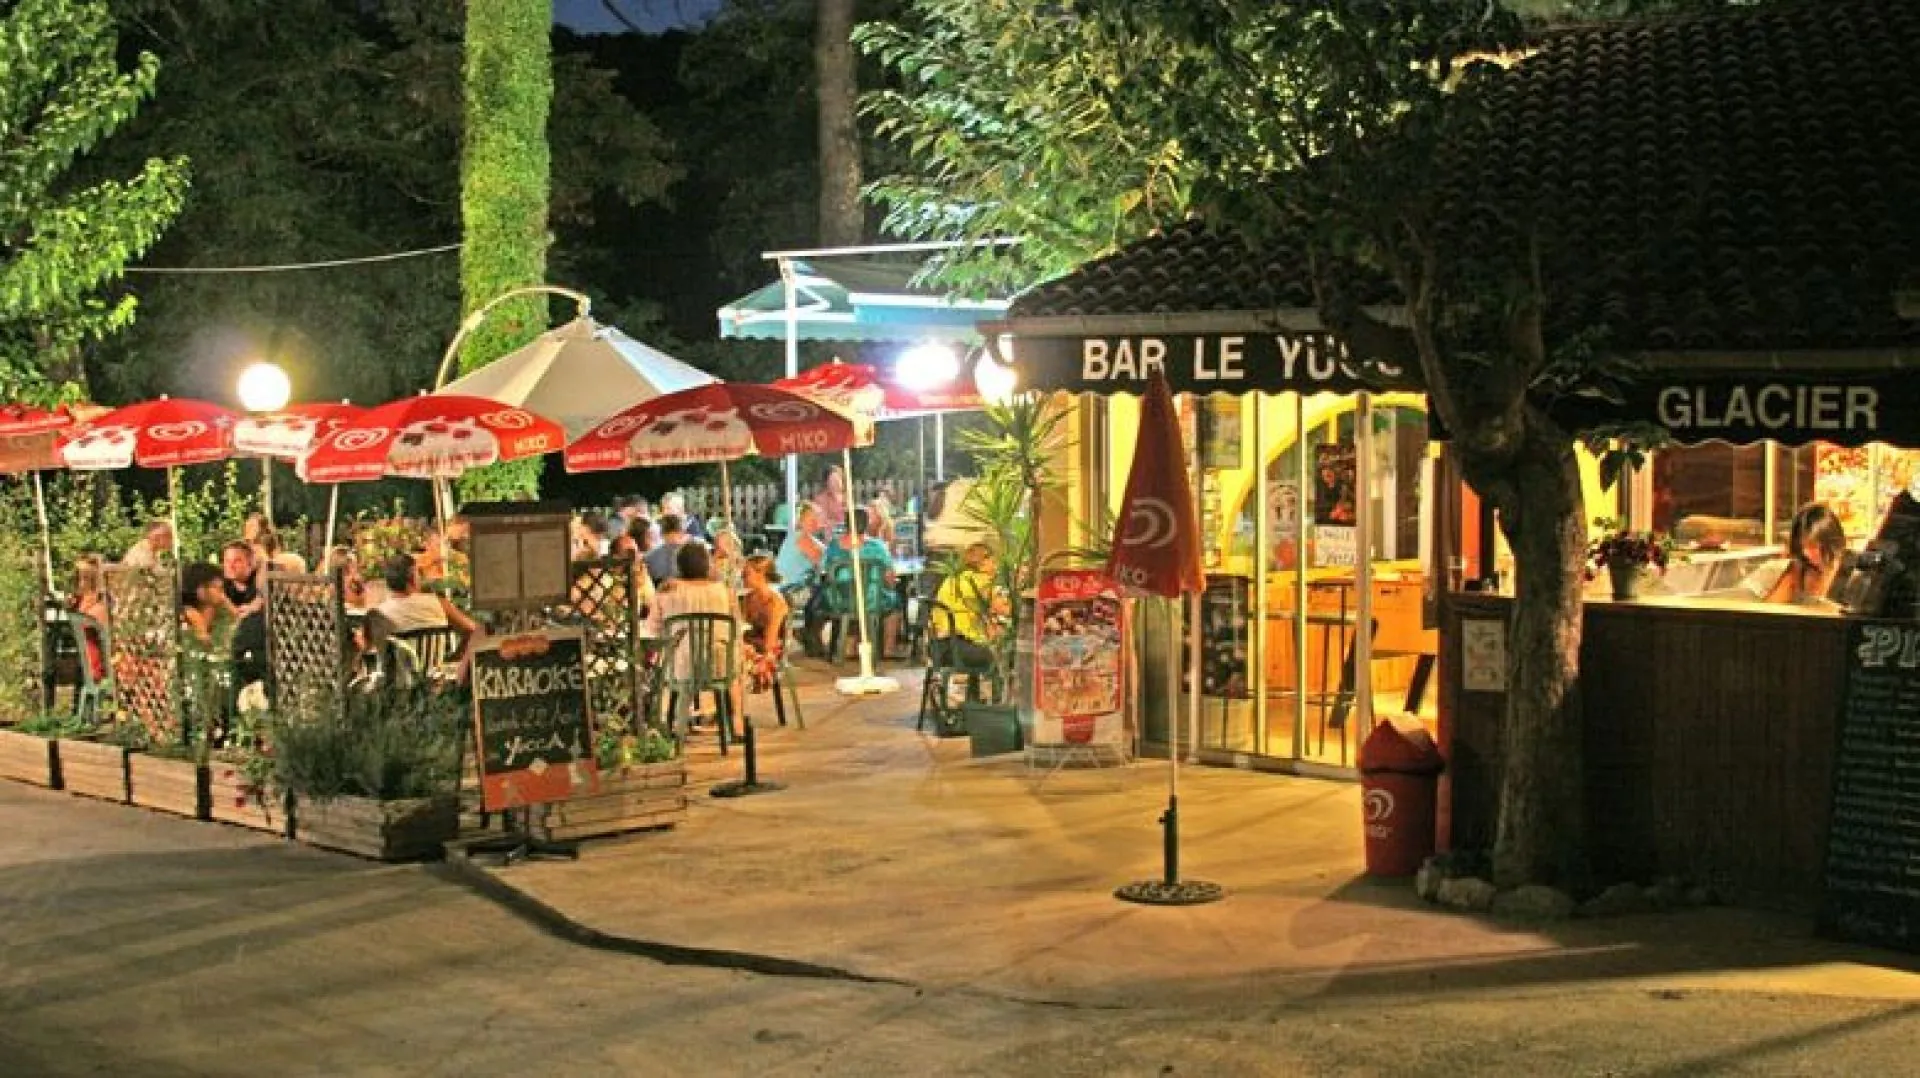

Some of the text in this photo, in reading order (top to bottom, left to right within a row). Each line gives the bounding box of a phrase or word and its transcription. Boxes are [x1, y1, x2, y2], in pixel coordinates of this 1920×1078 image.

[1081, 338, 1168, 381] BAR
[1193, 336, 1245, 380] LE
[1658, 384, 1880, 430] GLACIER
[779, 430, 829, 452] MIKO
